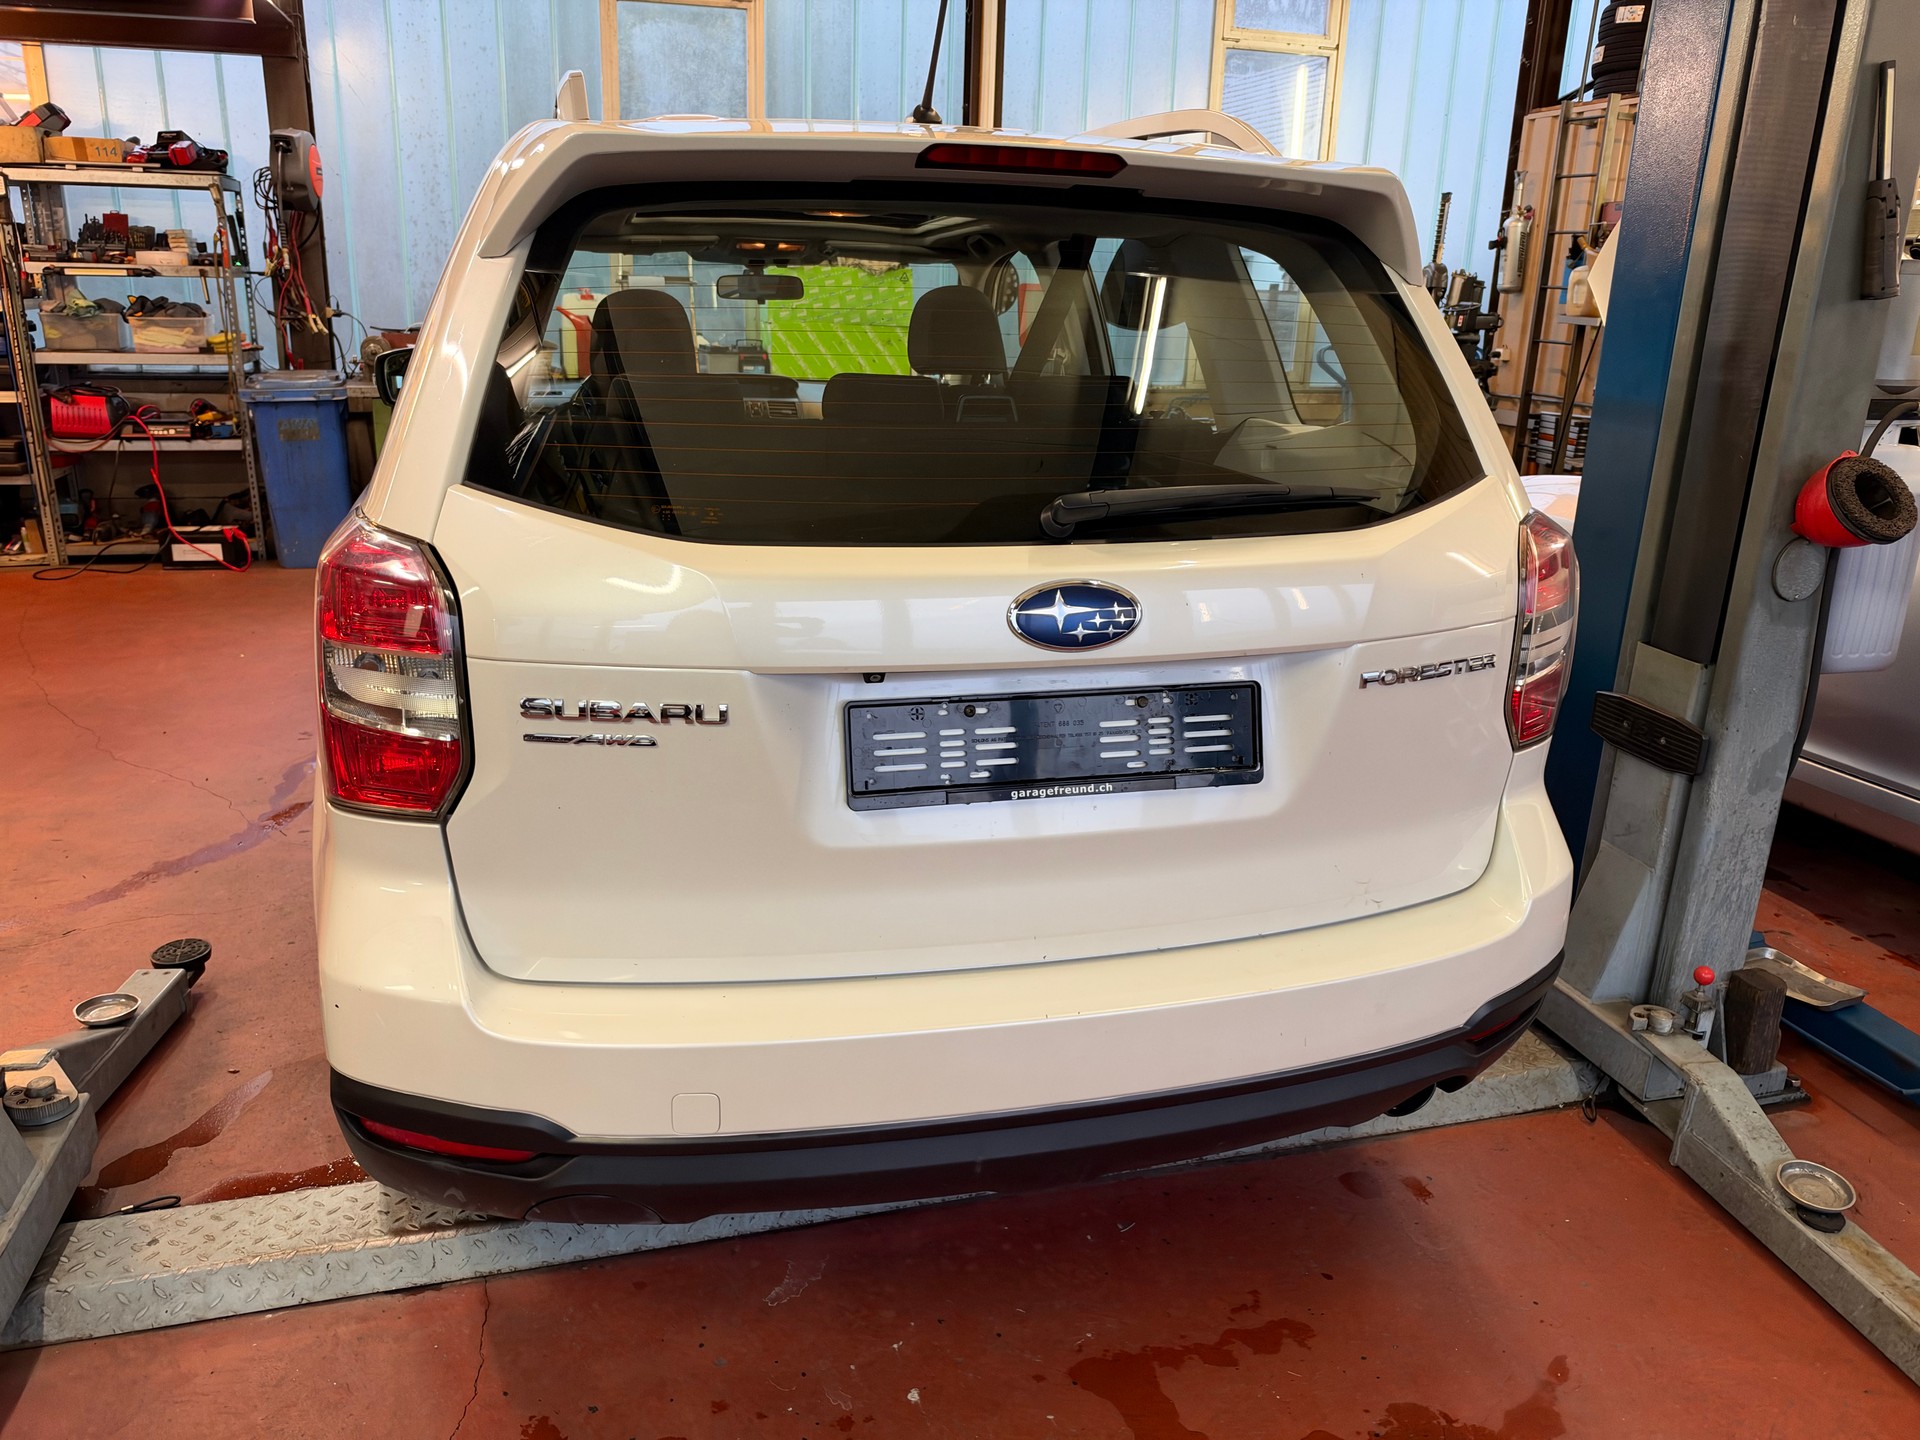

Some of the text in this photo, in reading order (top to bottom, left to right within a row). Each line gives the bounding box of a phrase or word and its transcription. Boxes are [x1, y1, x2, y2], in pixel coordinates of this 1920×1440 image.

[95, 146, 118, 158] 114
[1358, 653, 1497, 690] FORESTER
[519, 696, 730, 725] SUBARU
[572, 733, 659, 747] AWD
[1011, 783, 1113, 800] garagefreund.ch
